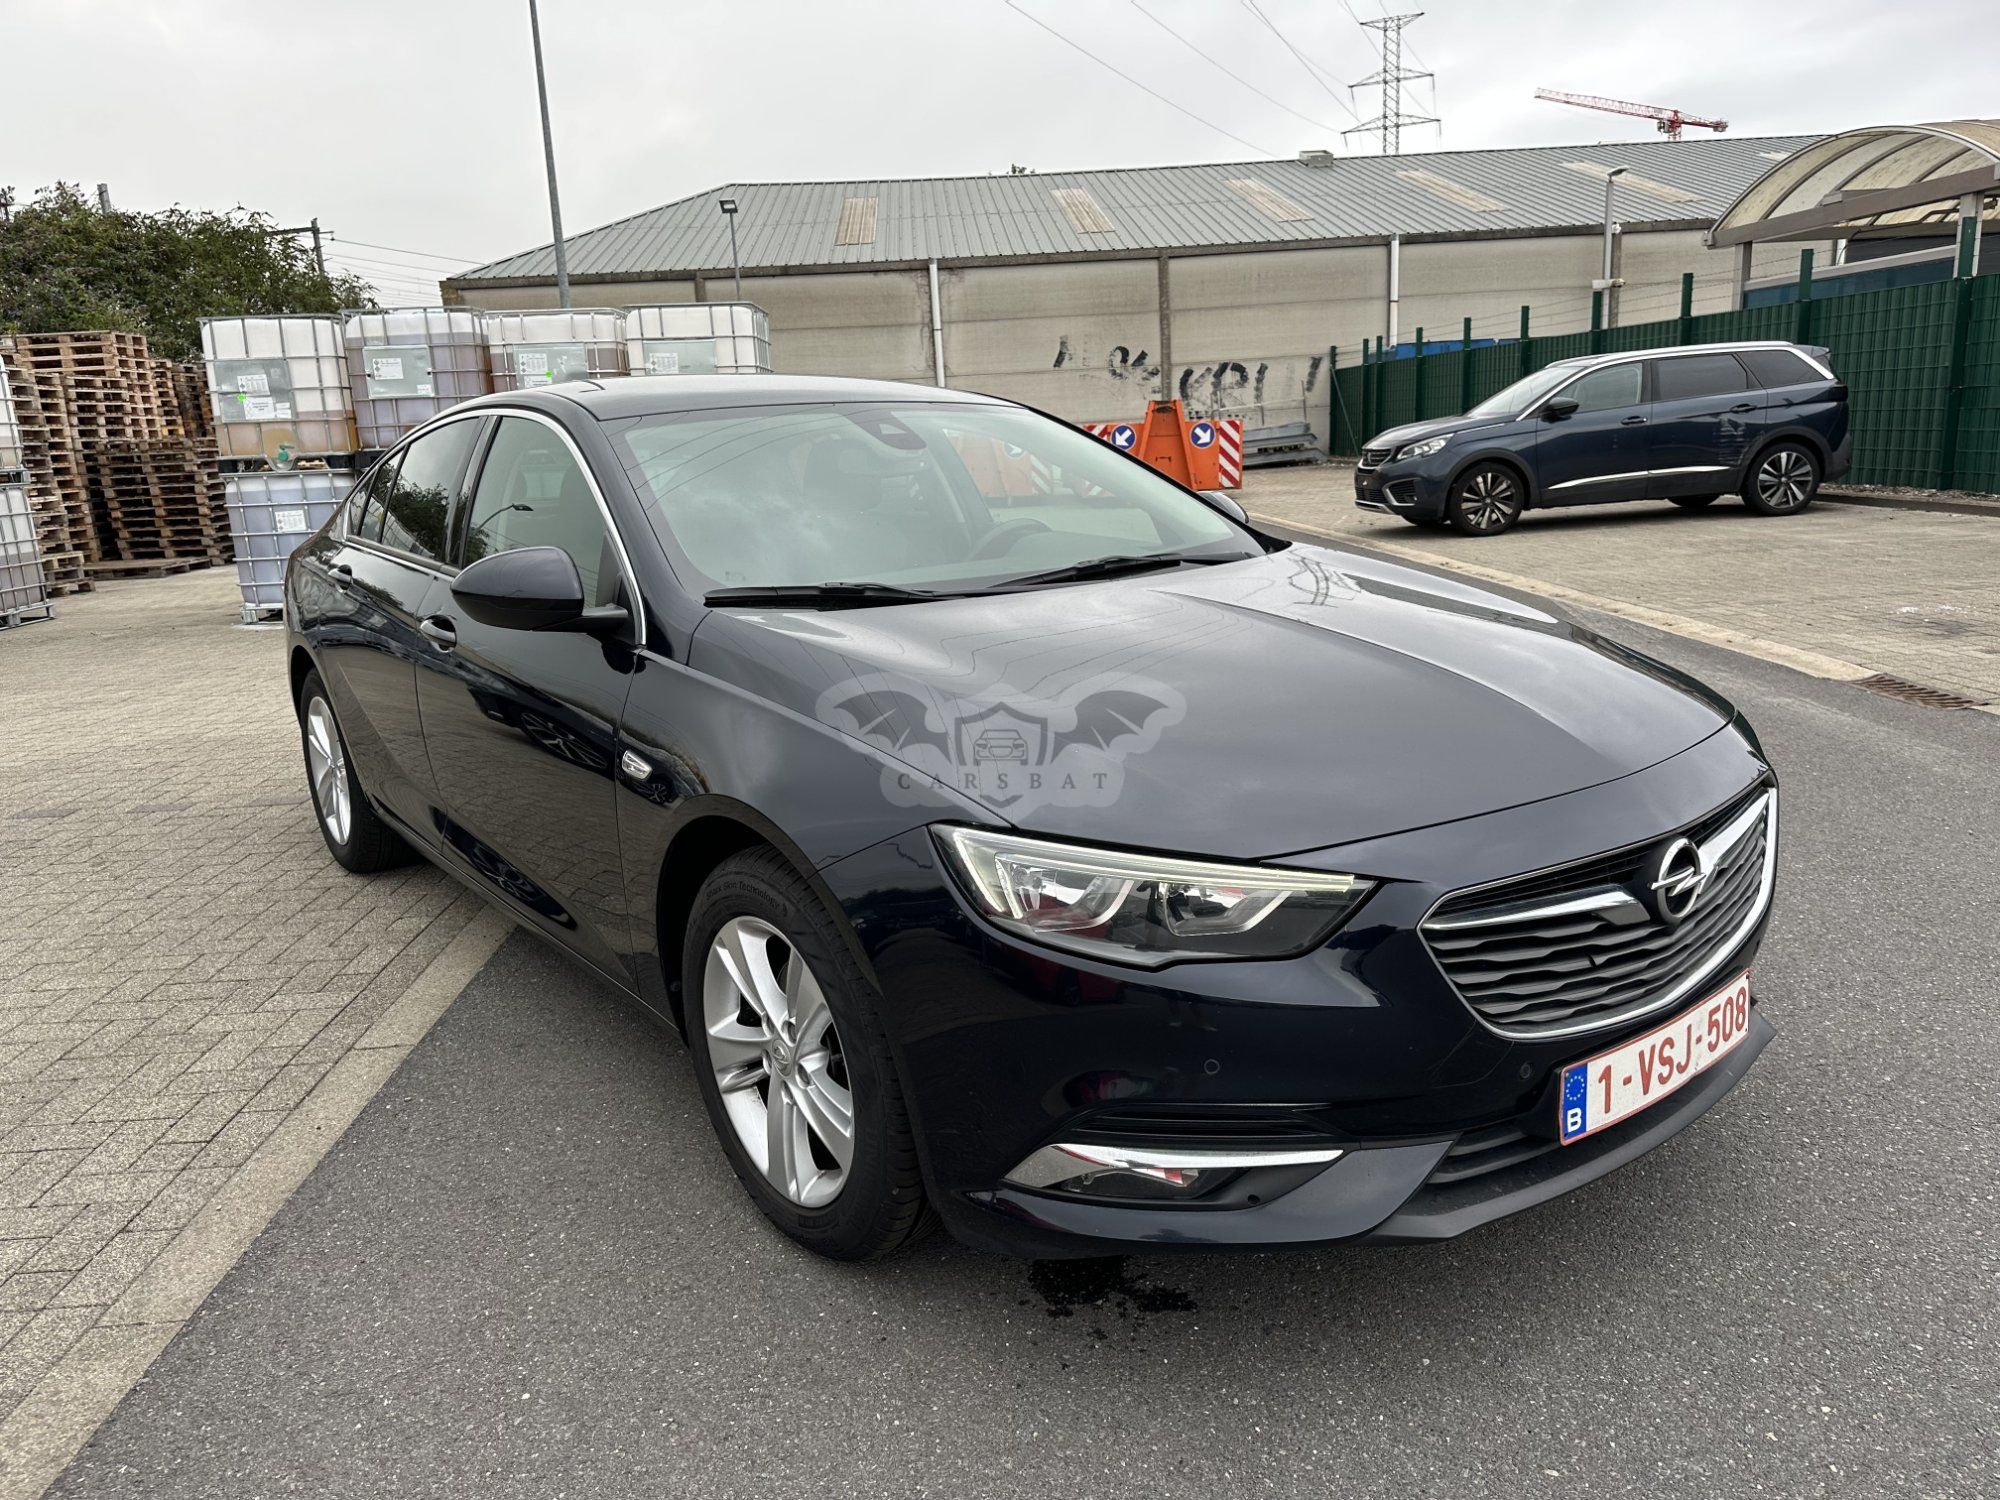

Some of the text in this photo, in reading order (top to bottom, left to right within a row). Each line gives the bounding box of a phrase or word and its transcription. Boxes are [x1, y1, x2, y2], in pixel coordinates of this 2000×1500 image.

[723, 881, 737, 891] Skin
[739, 880, 780, 910] Technology
[1598, 986, 1747, 1114] 1-VSJ-508
[1567, 1107, 1582, 1133] B
